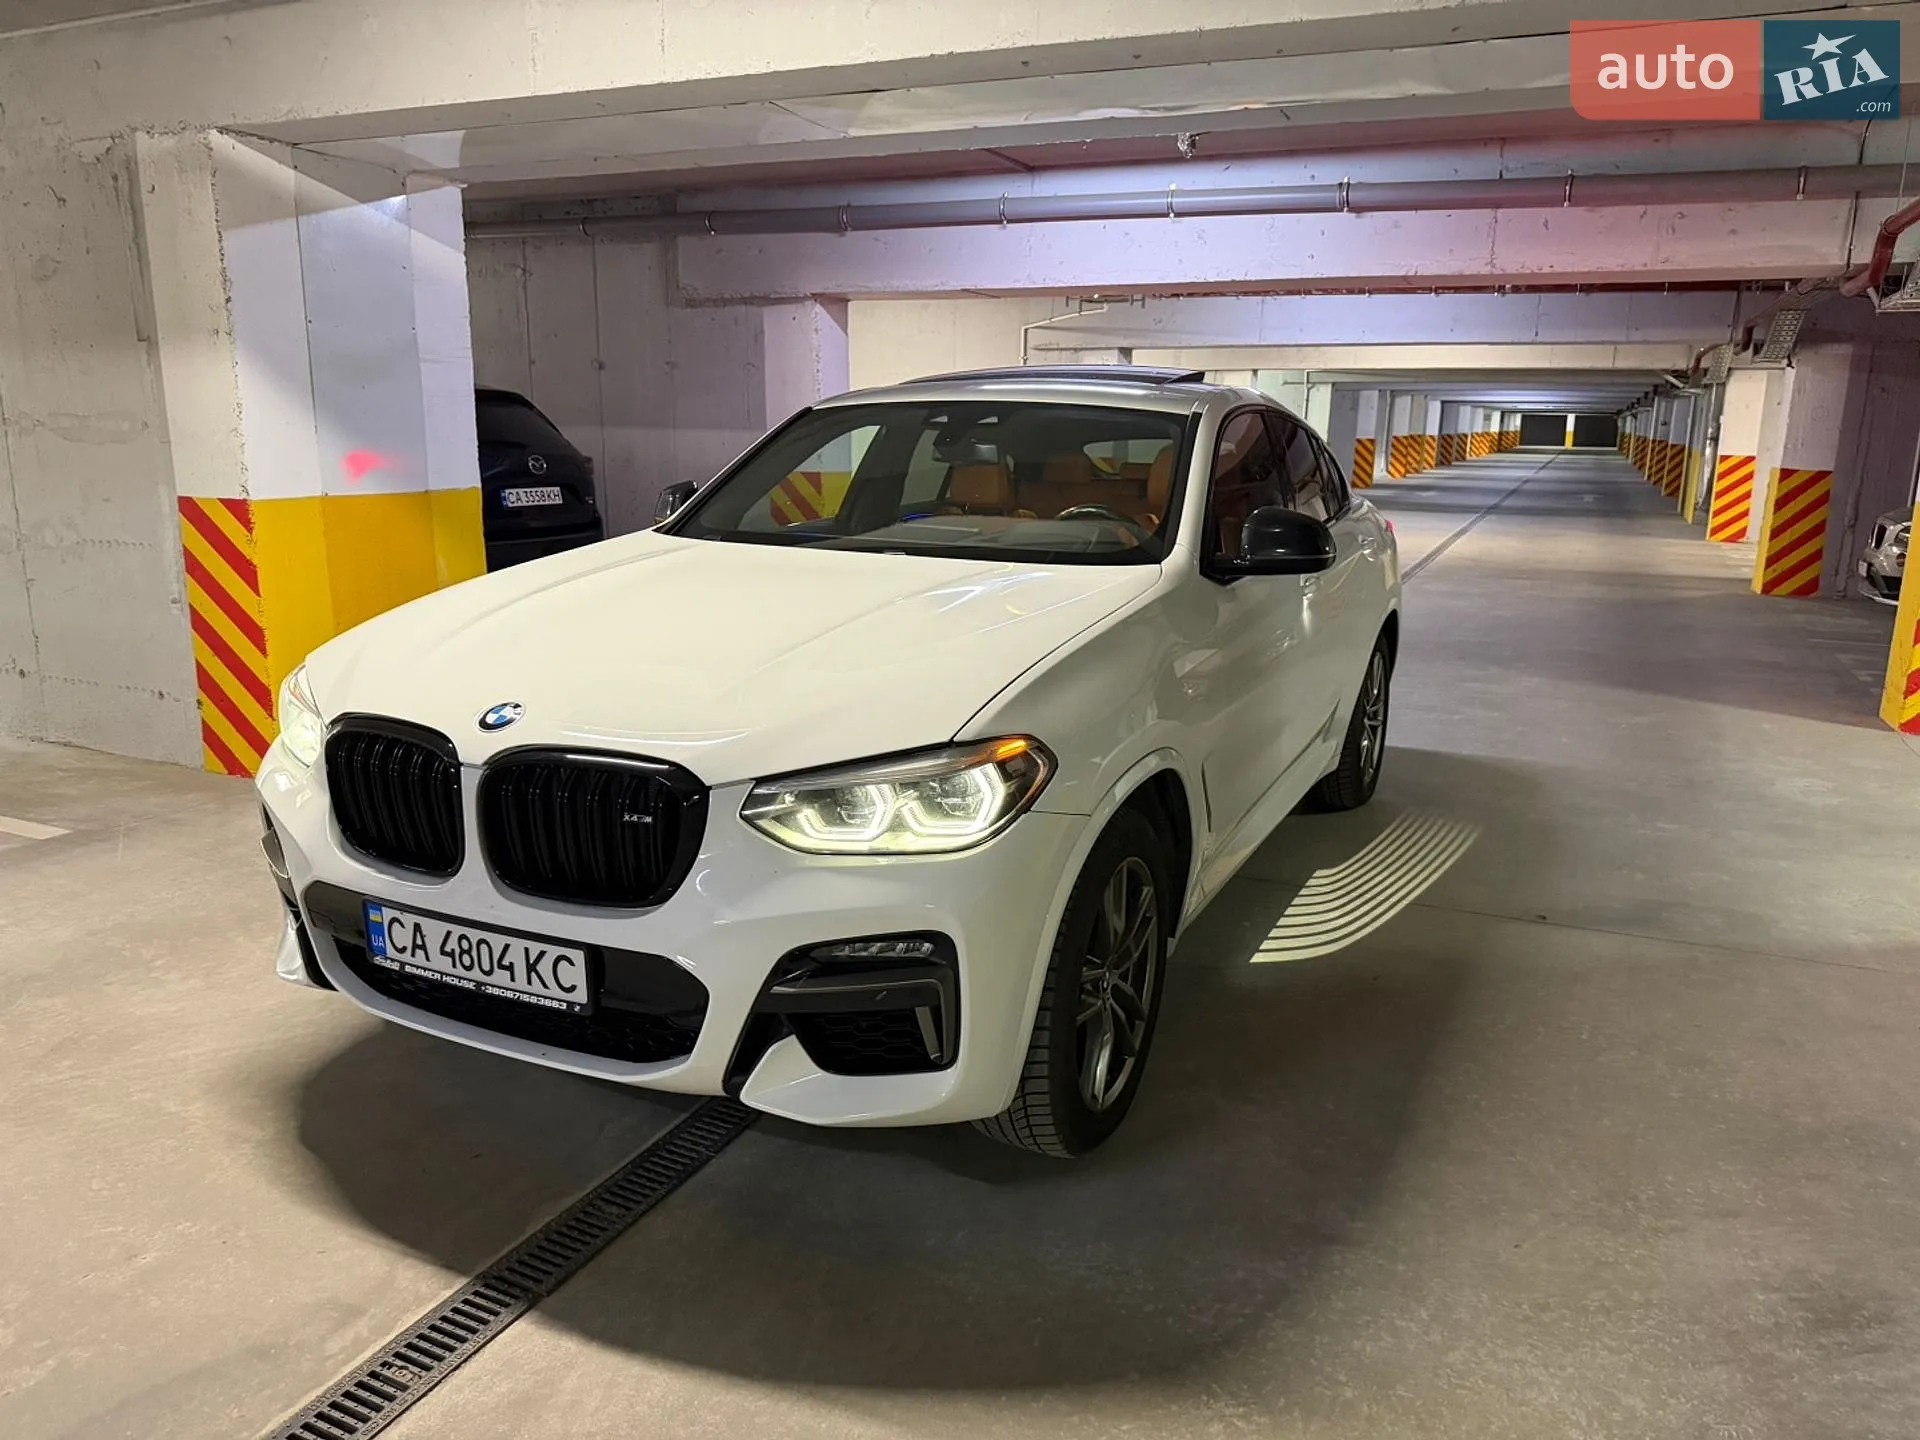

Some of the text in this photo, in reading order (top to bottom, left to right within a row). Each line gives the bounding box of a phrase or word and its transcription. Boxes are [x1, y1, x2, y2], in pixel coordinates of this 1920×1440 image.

[371, 934, 385, 948] UA
[387, 916, 578, 994] CA 4804 KC
[442, 974, 477, 990] HOUSE
